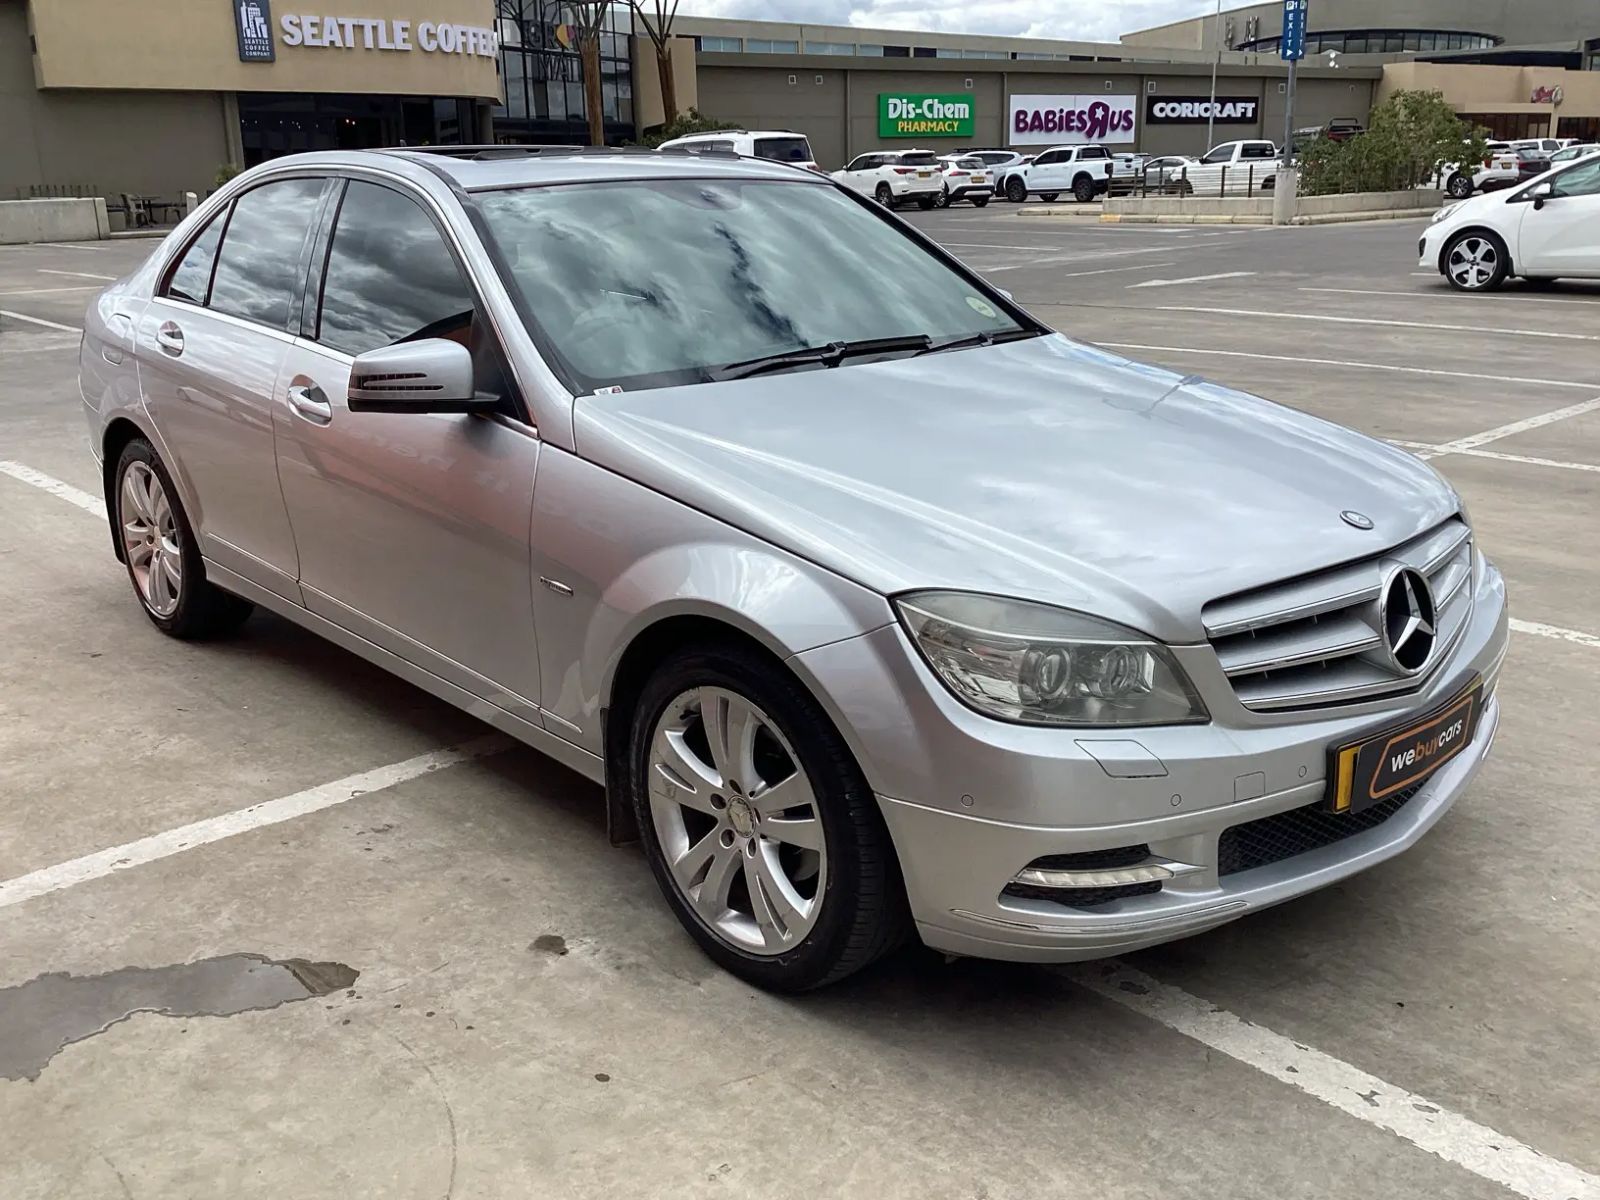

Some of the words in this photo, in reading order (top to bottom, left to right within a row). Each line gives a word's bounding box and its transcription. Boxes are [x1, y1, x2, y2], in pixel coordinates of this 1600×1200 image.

[281, 14, 412, 51] SEATTLE
[417, 21, 499, 58] COFFEE
[888, 98, 969, 119] Dis-Chem
[1152, 102, 1256, 118] CORICRAFT
[898, 121, 959, 133] PHARMACY
[1391, 719, 1463, 773] webuycars
